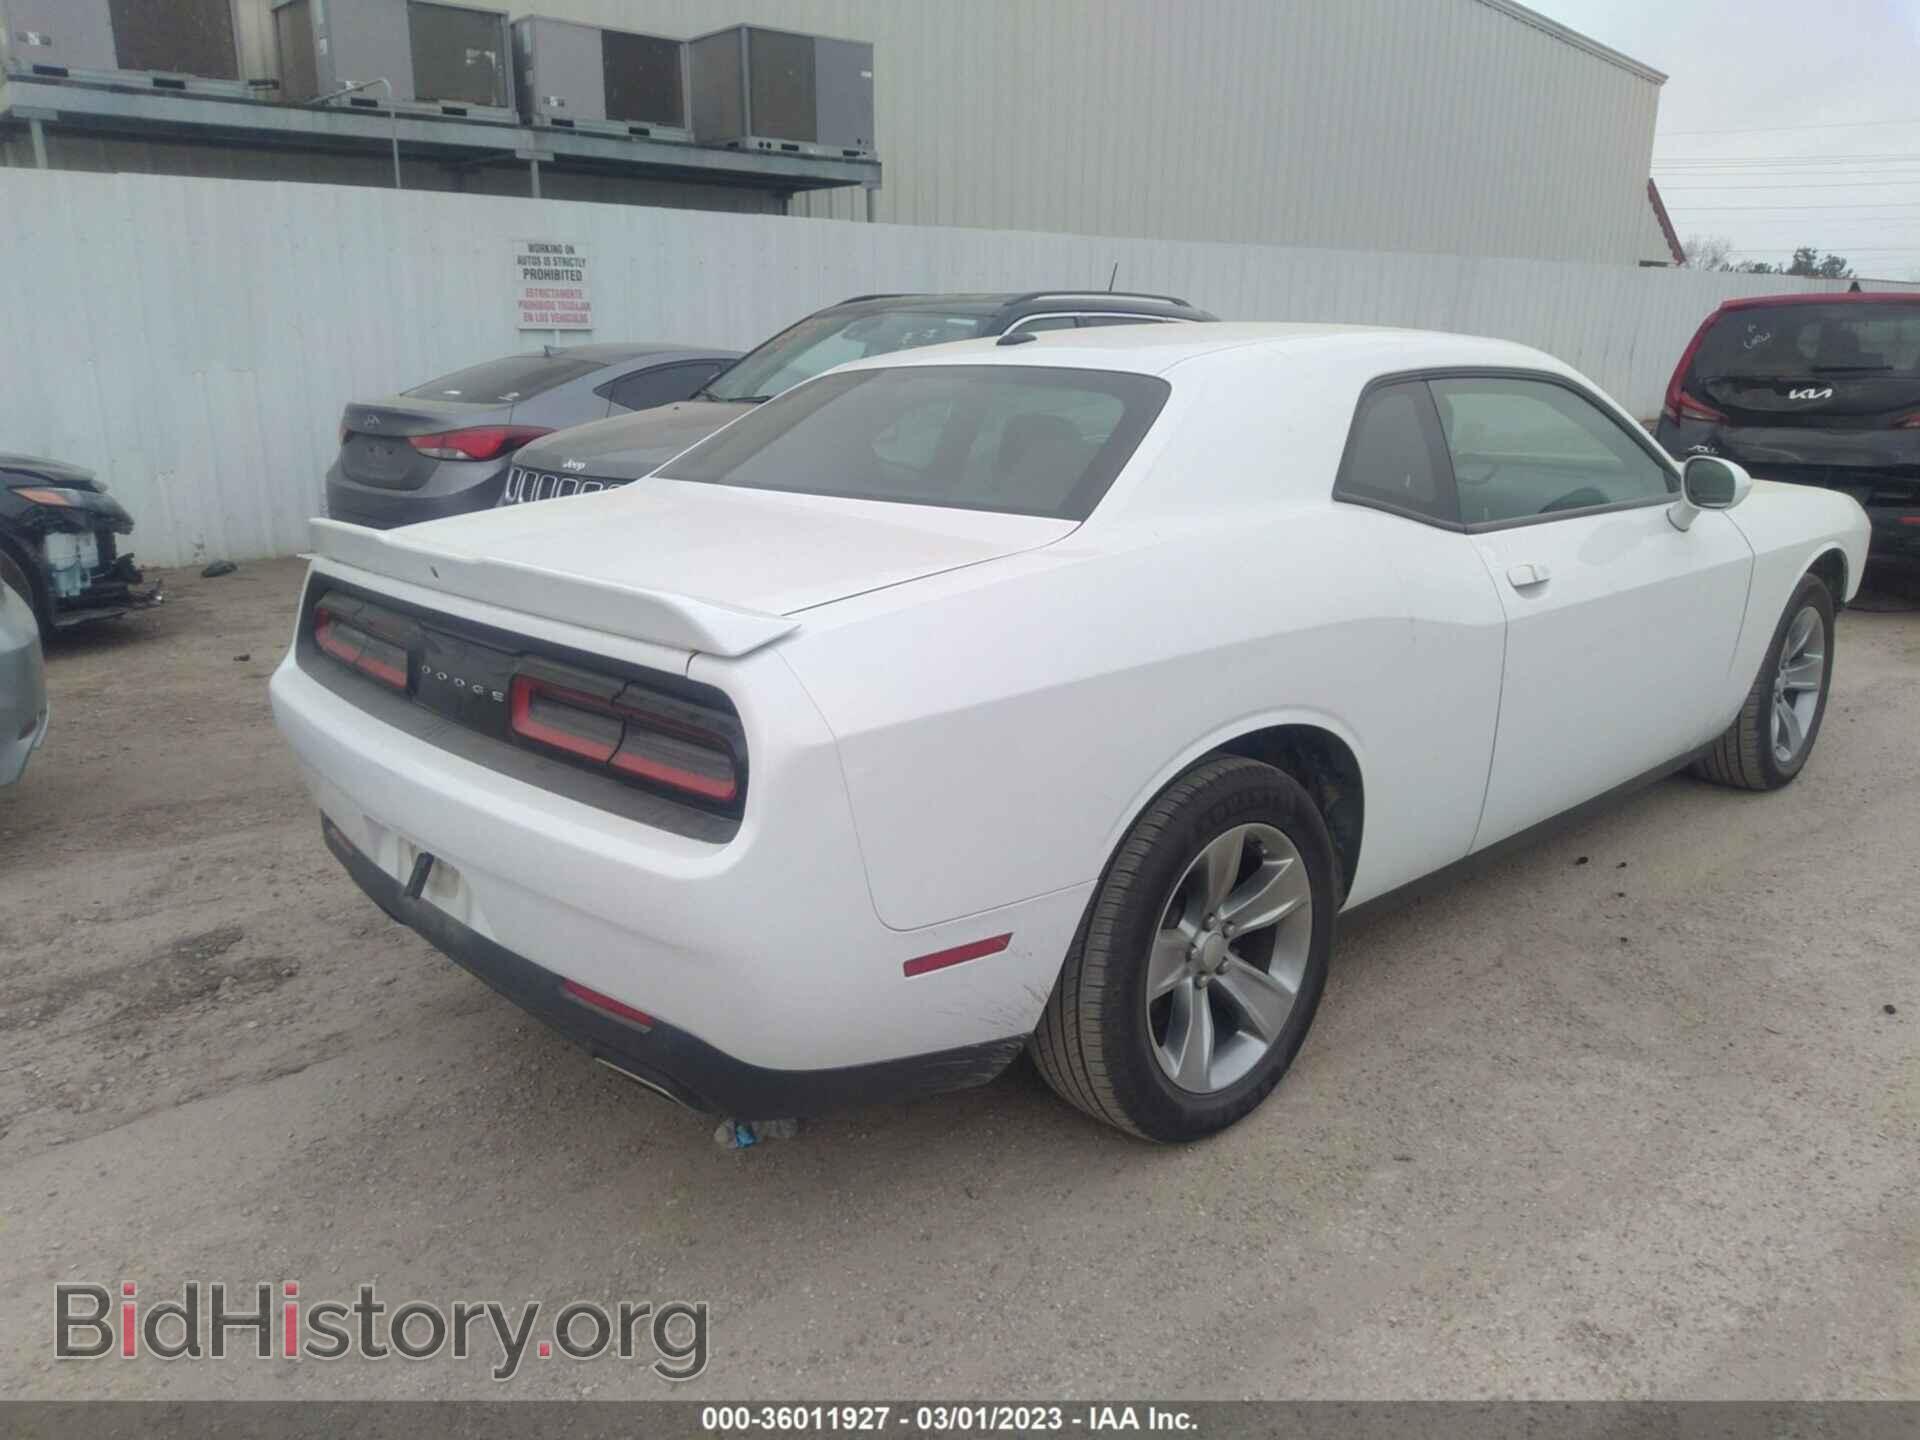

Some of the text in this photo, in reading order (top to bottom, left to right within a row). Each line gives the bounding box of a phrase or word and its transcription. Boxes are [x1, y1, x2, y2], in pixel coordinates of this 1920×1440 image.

[528, 244, 575, 255] WORKING ON
[517, 256, 541, 266] AUTOS
[553, 256, 586, 268] STRICTLY
[523, 268, 582, 281] PROHIBITED
[558, 301, 591, 312] TAJAR
[551, 313, 588, 324] VEULOS
[1789, 388, 1833, 400] KIA
[421, 664, 505, 703] DODGE
